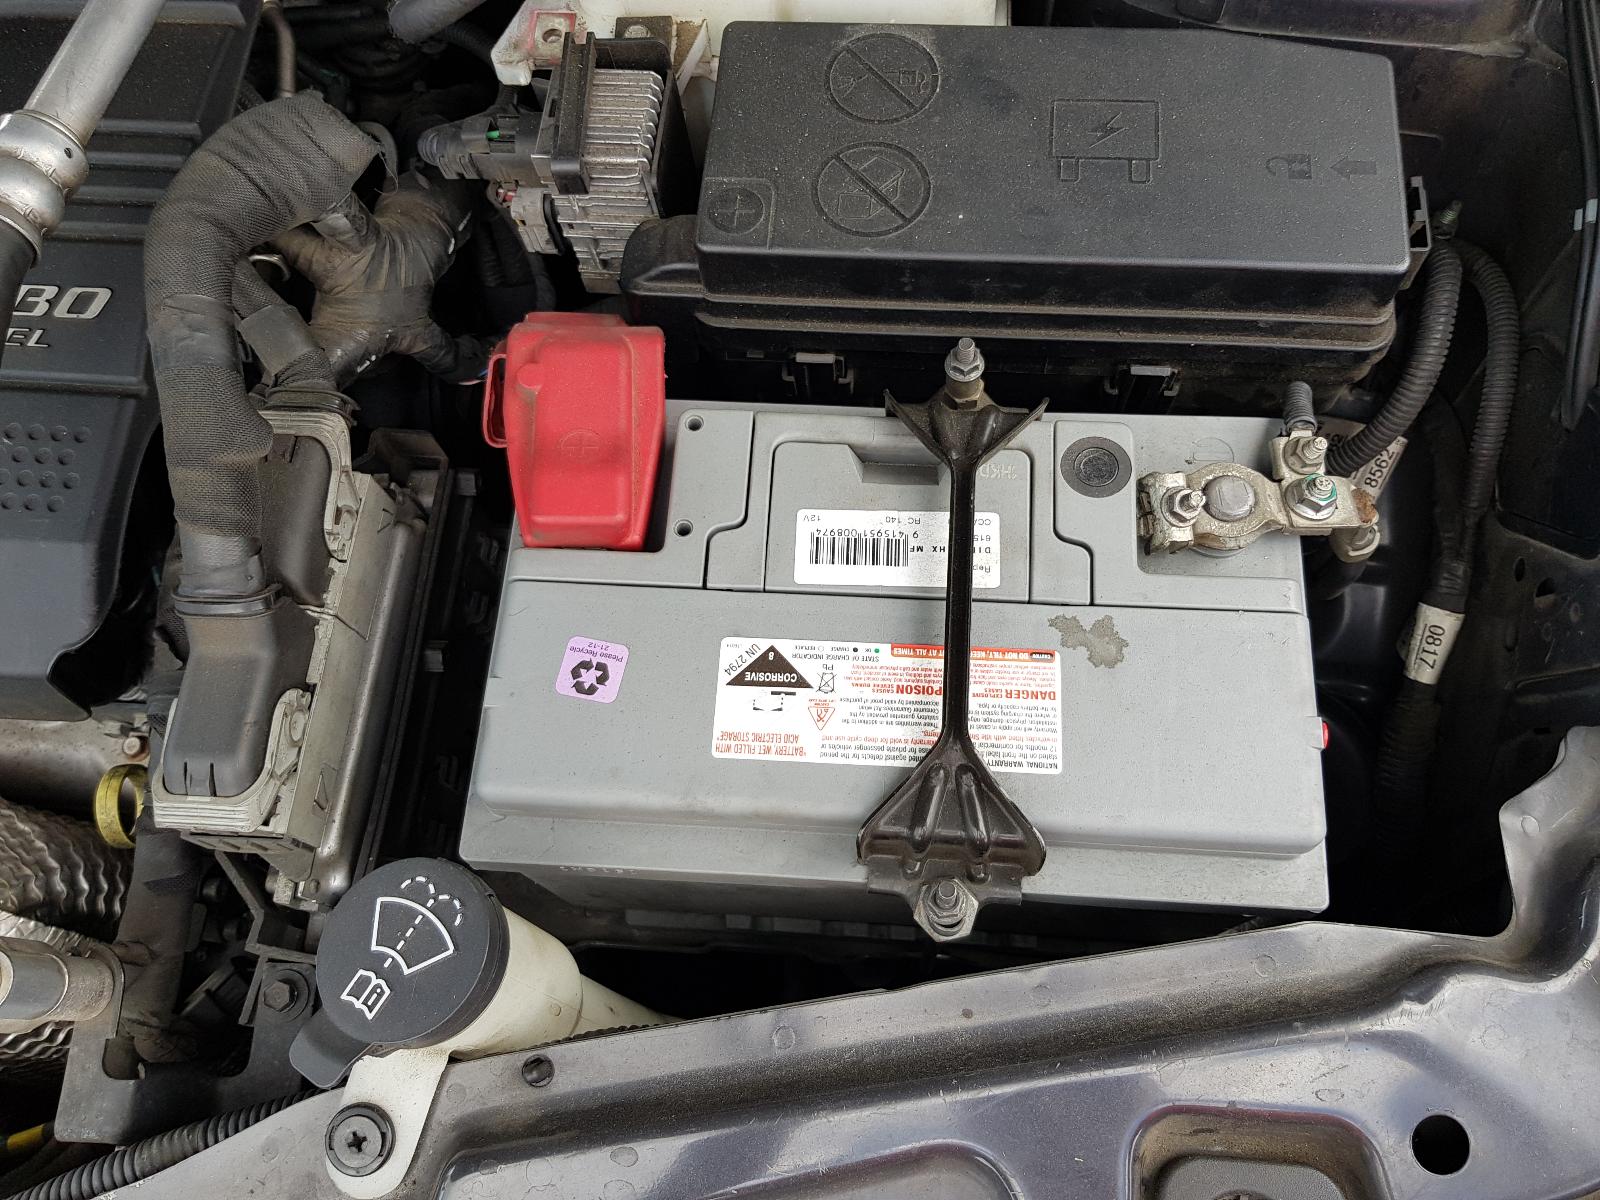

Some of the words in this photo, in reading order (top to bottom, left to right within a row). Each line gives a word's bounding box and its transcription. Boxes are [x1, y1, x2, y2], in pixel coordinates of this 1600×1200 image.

[12, 284, 113, 319] BO
[1364, 448, 1396, 488] 8562
[816, 528, 857, 537] 008974
[864, 530, 904, 538] 415951
[912, 530, 918, 538] 9
[570, 646, 598, 658] Recycle
[745, 644, 760, 656] UN
[1420, 624, 1446, 669] 0817
[600, 652, 623, 663] Please
[768, 652, 775, 660] 8
[724, 655, 747, 676] 2794
[744, 672, 798, 682] CORROSIVE
[896, 684, 943, 695] POISON
[1005, 689, 1056, 700] DANGER
[752, 732, 782, 743] ELECTRIC
[784, 734, 799, 744] ACID
[716, 742, 732, 753] WITH
[734, 743, 756, 754] FILLED
[987, 760, 1024, 768] WARRANTY
[1026, 761, 1058, 769] NATIONAL
